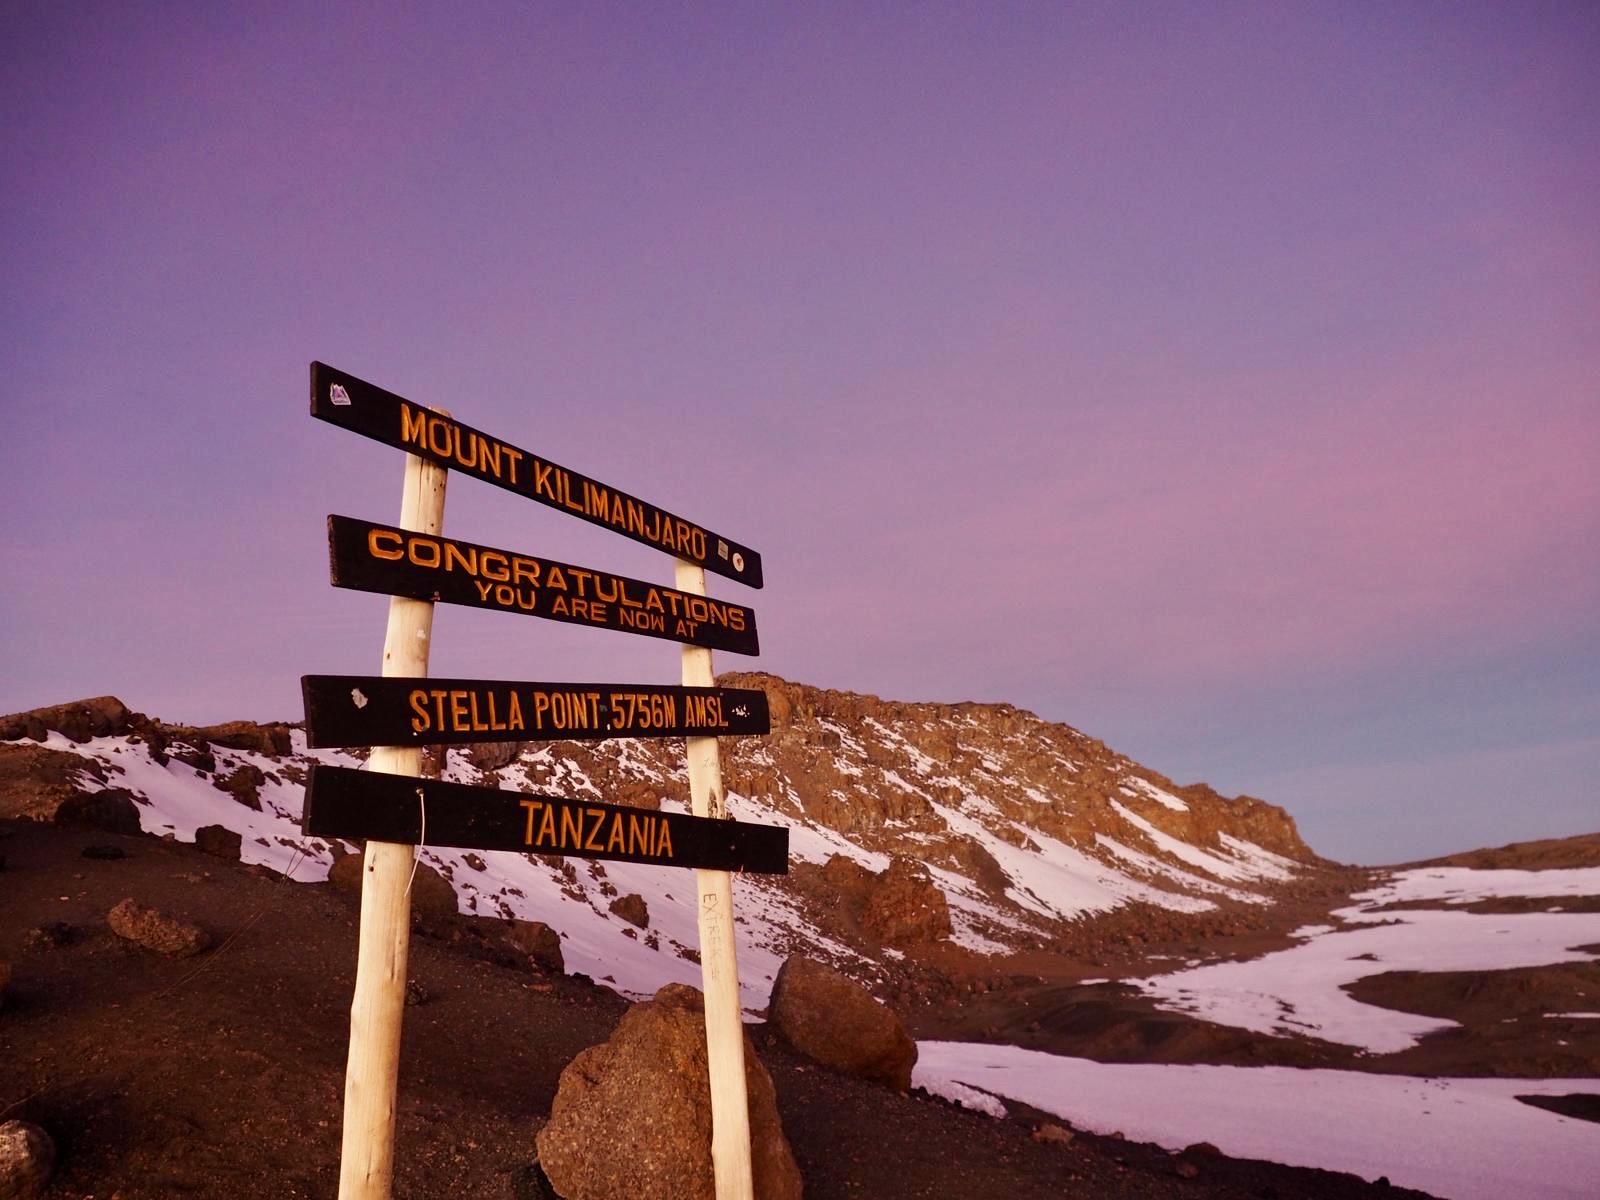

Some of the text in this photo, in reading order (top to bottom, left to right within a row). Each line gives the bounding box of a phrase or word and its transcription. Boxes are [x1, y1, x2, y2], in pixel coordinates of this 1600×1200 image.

[401, 403, 706, 560] MOUNT KILIMANJARO
[368, 529, 744, 631] CONGRATULATIONS
[474, 580, 698, 638] YOU ARE NOW AT
[409, 690, 729, 732] STELLA POINT 5756M AMSL
[519, 799, 674, 857] TANZANIA
